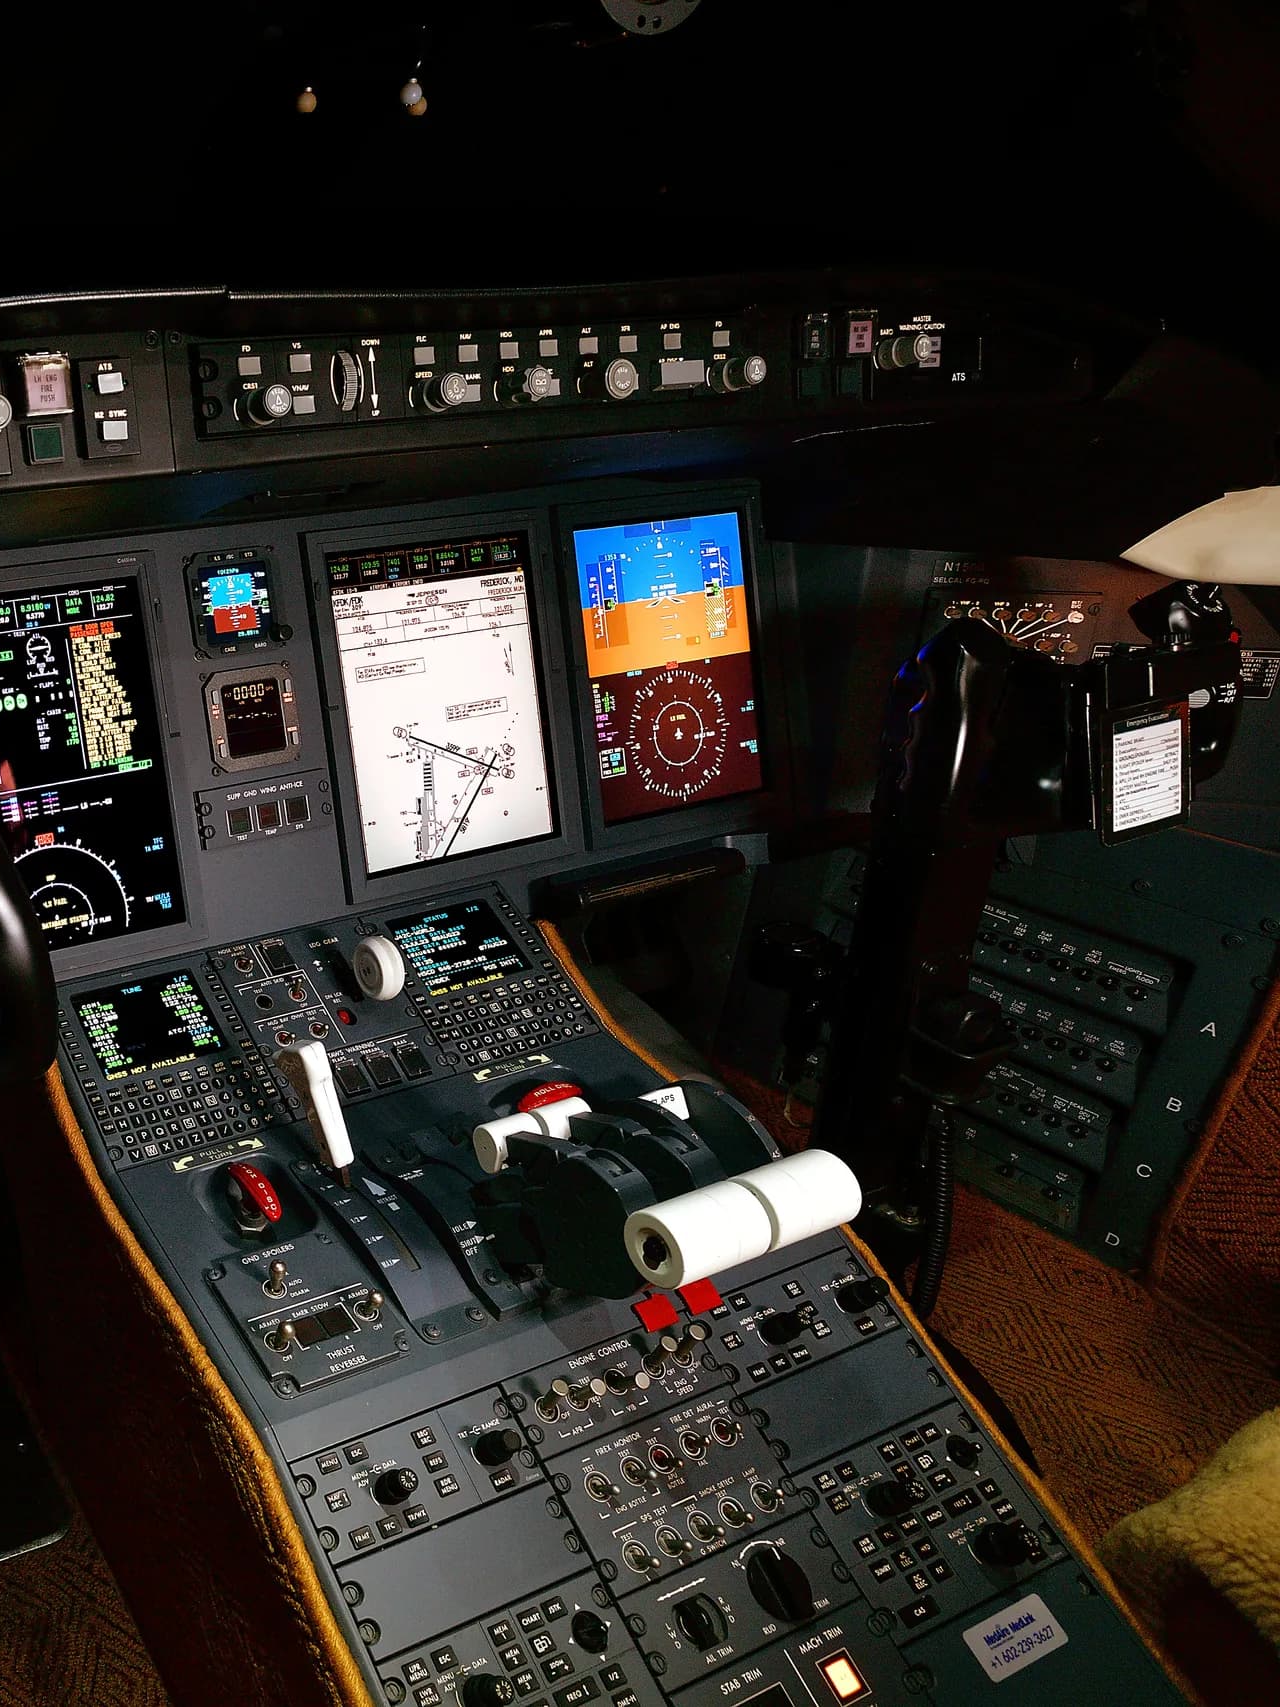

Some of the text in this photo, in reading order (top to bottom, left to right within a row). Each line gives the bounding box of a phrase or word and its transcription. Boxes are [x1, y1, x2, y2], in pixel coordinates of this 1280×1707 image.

[912, 314, 932, 323] MASTER
[899, 322, 946, 331] WARNING/CAUTION
[416, 335, 427, 343] FLC
[291, 342, 301, 350] VS
[98, 363, 113, 371] ATS
[502, 365, 515, 373] HDG
[45, 373, 58, 383] ENG
[415, 370, 433, 379] SPEED
[951, 372, 966, 382] ATS
[39, 382, 54, 393] FIRE
[291, 384, 309, 392] VNAV
[39, 393, 56, 404] PUSH
[107, 408, 128, 418] SYNC
[65, 598, 83, 607] DATA
[243, 780, 304, 798] GND WING ANTI-ICE
[422, 912, 449, 923] STATUS
[322, 937, 339, 946] GEAR
[173, 975, 189, 983] 1/2
[450, 972, 505, 992] NOT AVAILABLE
[121, 985, 143, 996] TUNE
[189, 1026, 214, 1036] TA/RA
[1199, 1021, 1217, 1037] A
[346, 1041, 375, 1054] WARNING
[106, 1053, 196, 1082] GNSS NOT AVAILABLE
[533, 1085, 554, 1098] ROLL
[1166, 1097, 1182, 1112] B
[1135, 1164, 1153, 1178] C
[459, 1239, 477, 1250] SHUT
[1105, 1233, 1120, 1246] D
[241, 1243, 295, 1265] GND SPOILERS
[292, 1301, 329, 1319] EMER STOW
[326, 1345, 356, 1359] THRUST
[568, 1339, 632, 1369] ENGINE CONTROL
[329, 1355, 368, 1373] REVERSER
[676, 1383, 694, 1396] SPEED
[669, 1400, 715, 1424] FIRE DET AURAL
[595, 1432, 642, 1456] FIREX MONITOR
[321, 1457, 339, 1469] MENU
[494, 1474, 512, 1486] RADAR
[640, 1506, 668, 1523] SPS TEST
[913, 1606, 926, 1617] CAS
[521, 1612, 541, 1626] CHART
[983, 1625, 1011, 1646] MedAire
[1008, 1612, 1036, 1633] MedLink
[798, 1625, 844, 1655] MACH TRIM
[991, 1655, 1003, 1669] +1
[1002, 1625, 1055, 1664] 602-239-3627
[705, 1645, 734, 1665] AIL TRIM
[720, 1667, 763, 1696] STAB TRIM
